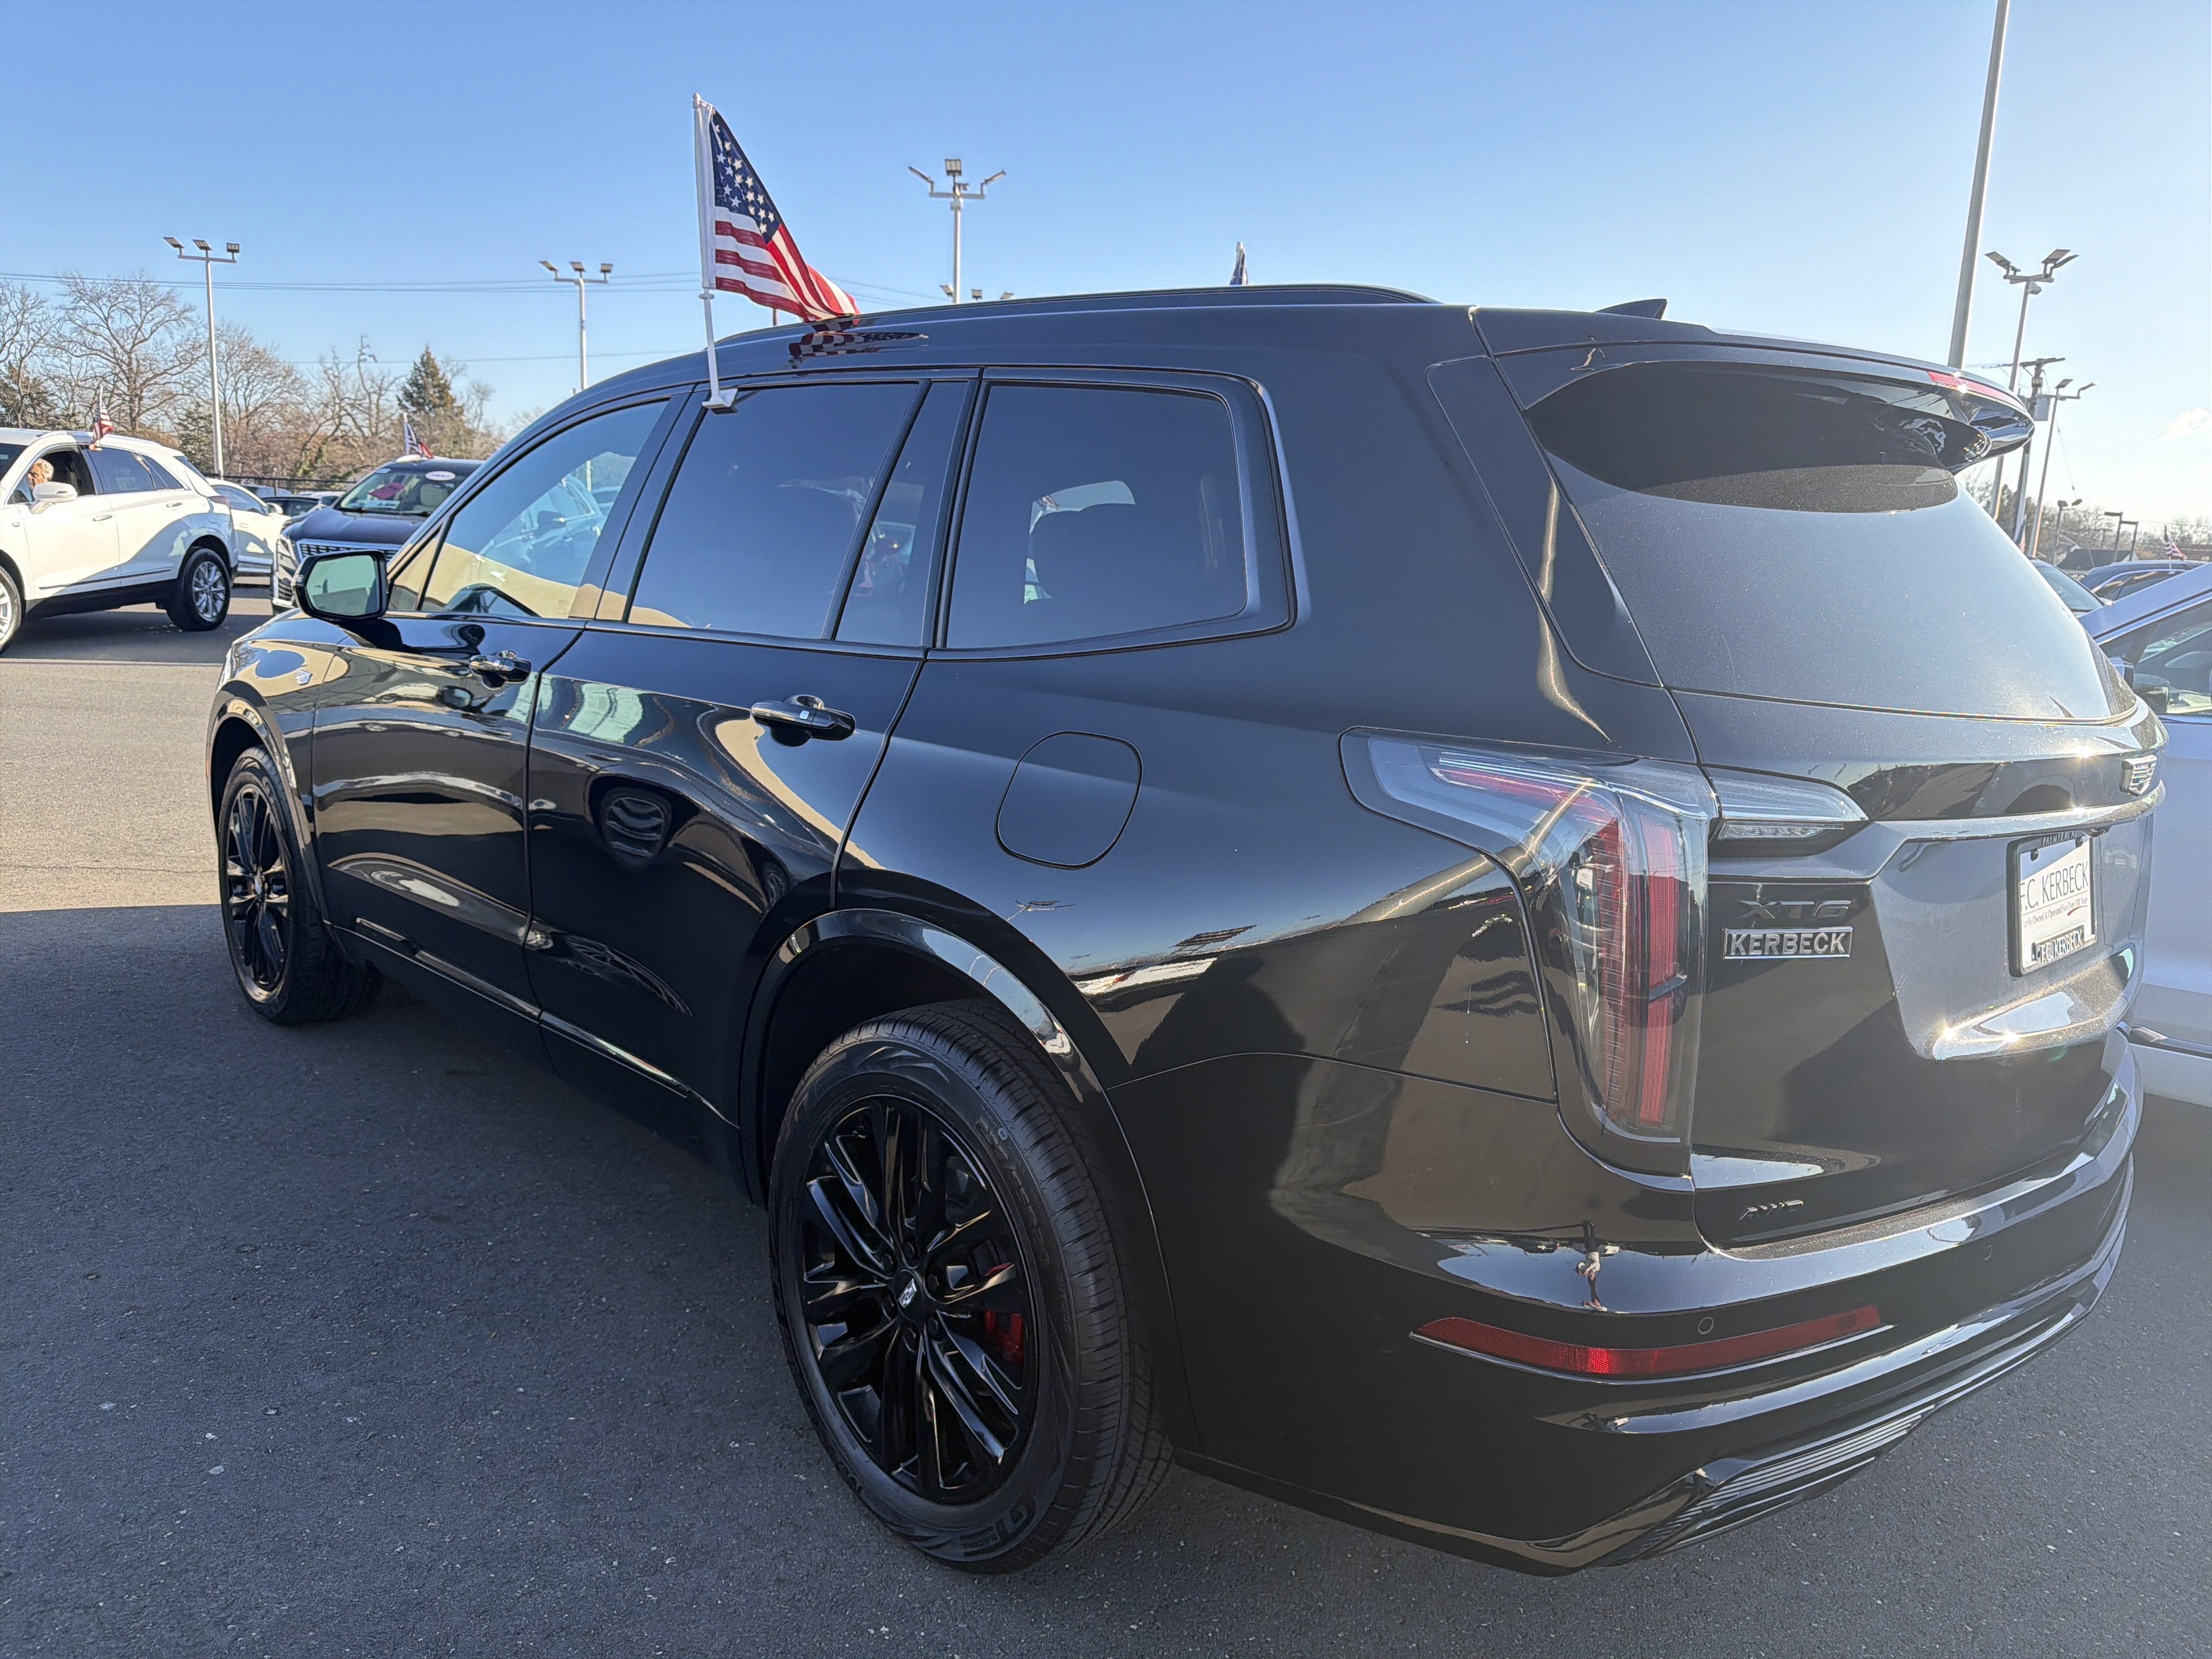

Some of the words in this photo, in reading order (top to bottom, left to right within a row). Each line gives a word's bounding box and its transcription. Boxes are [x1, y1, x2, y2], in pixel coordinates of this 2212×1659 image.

[2042, 861, 2089, 904] KERBECK
[1730, 932, 1846, 956] KERBECK
[2053, 928, 2083, 958] KERBECK
